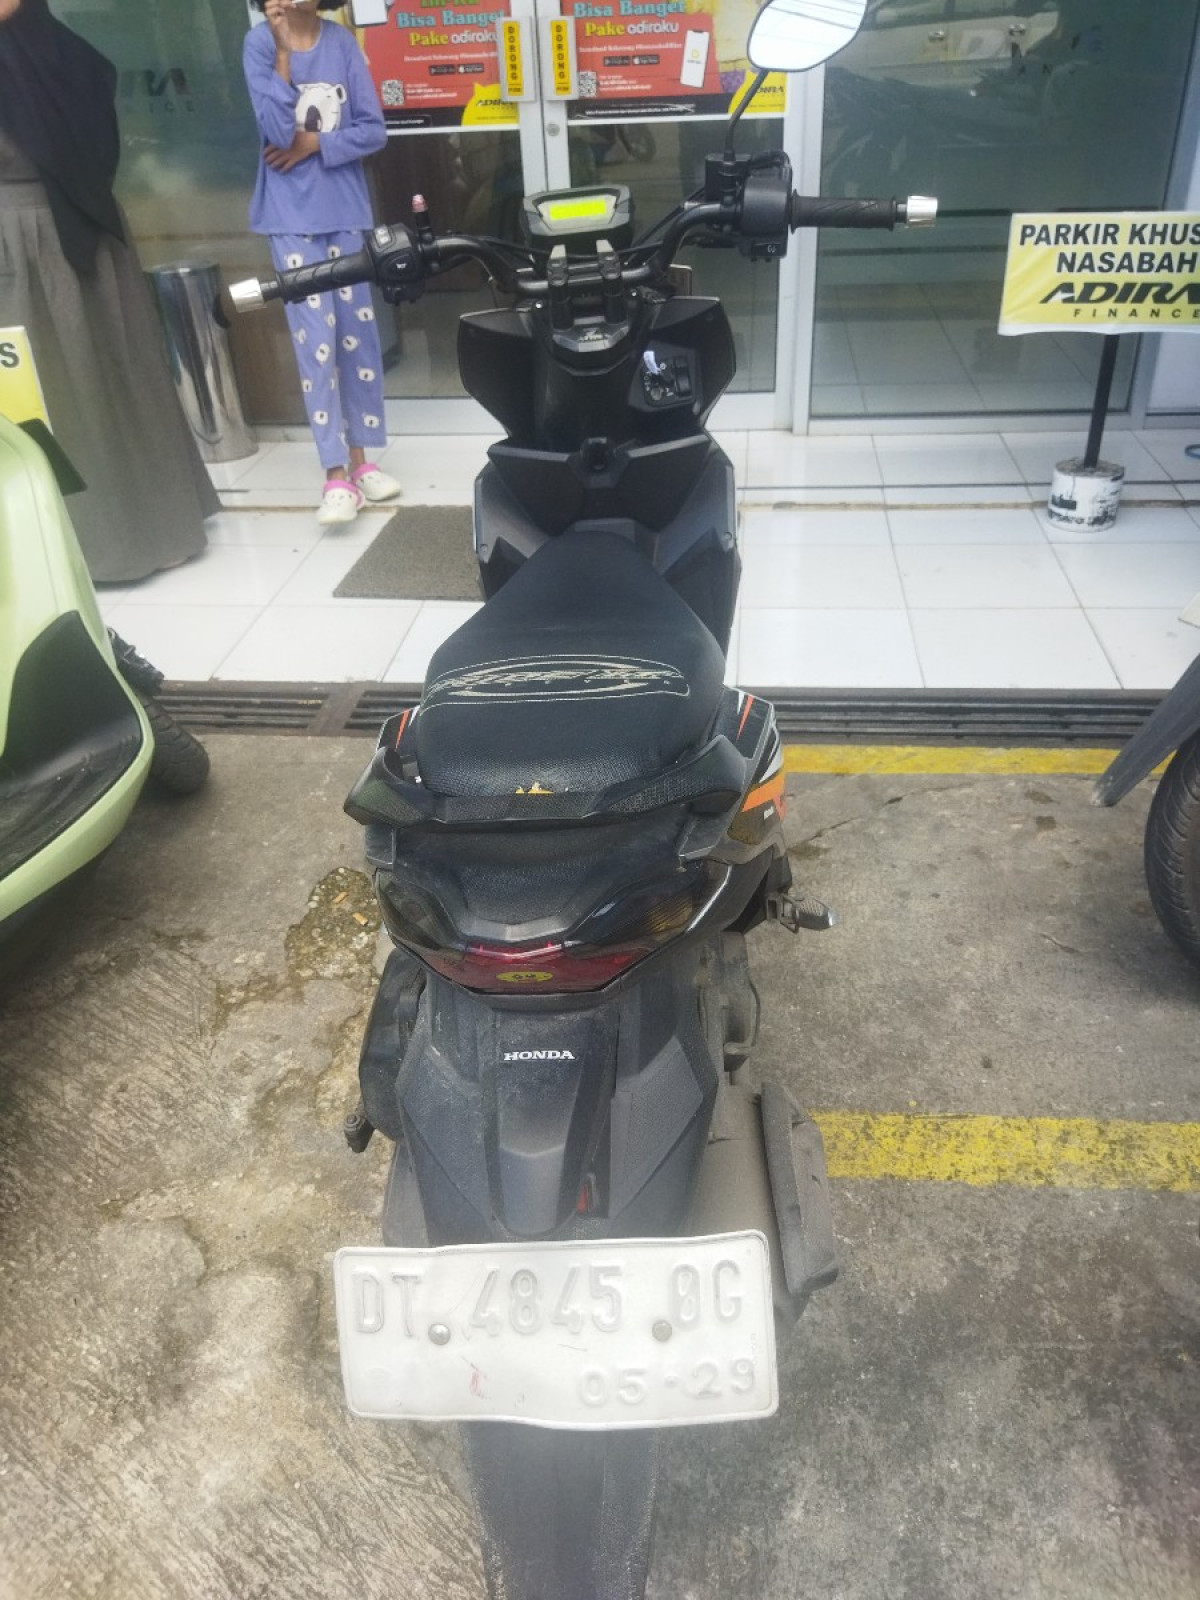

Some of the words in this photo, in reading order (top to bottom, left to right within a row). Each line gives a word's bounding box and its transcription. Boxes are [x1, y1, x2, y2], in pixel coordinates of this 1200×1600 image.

[573, 2, 613, 18] Bisa
[397, 12, 436, 28] Bisa
[584, 21, 625, 37] Pake
[408, 30, 448, 46] Pake
[507, 25, 518, 80] DORONG
[555, 24, 565, 79] DORONG
[1019, 223, 1120, 246] PARKIR
[1056, 251, 1198, 273] NASABAH
[1039, 282, 1200, 304] ADIRA
[1073, 308, 1200, 318] FINANCE
[503, 1050, 576, 1061] HONDA
[352, 1271, 422, 1337] DT
[469, 1265, 623, 1335] 4845
